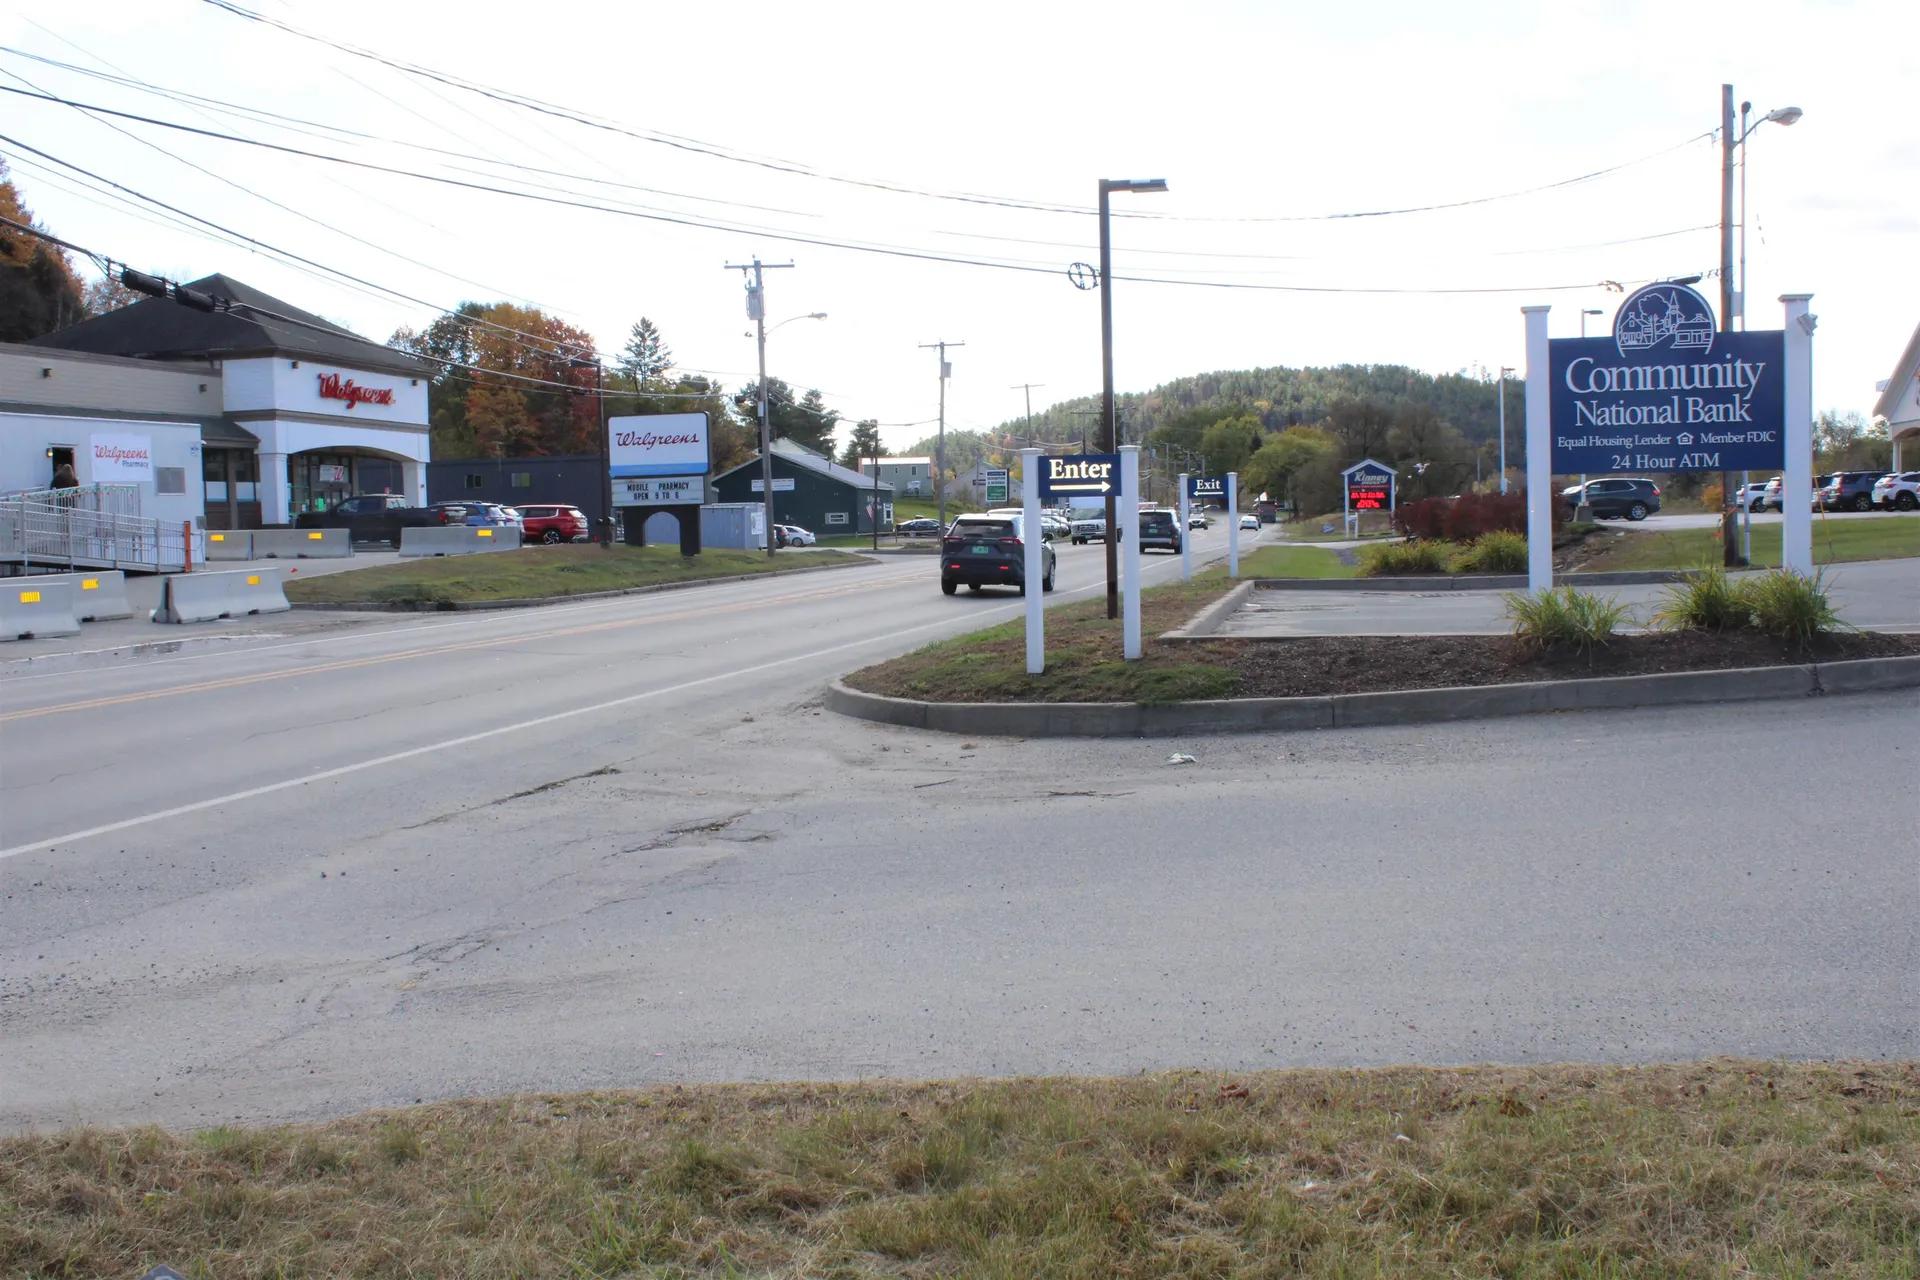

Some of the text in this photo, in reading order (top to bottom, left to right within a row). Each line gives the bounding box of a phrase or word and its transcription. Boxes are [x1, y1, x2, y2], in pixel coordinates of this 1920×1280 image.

[1565, 353, 1766, 400] Community
[317, 372, 395, 409] Walgreens
[1574, 393, 1753, 427] National Bank
[616, 431, 700, 451] Walgreens
[1557, 431, 1776, 450] Equal Housing Lender Member FDIC
[94, 444, 148, 464] Walgreens
[1611, 452, 1720, 469] 24 Hour ATM
[122, 460, 149, 469] Pharmacy
[1049, 459, 1112, 480] Enter
[627, 482, 689, 491] MOBILE PHARMACY
[1196, 479, 1221, 490] Exit
[1354, 470, 1389, 484] Kinney
[662, 491, 670, 499] TO
